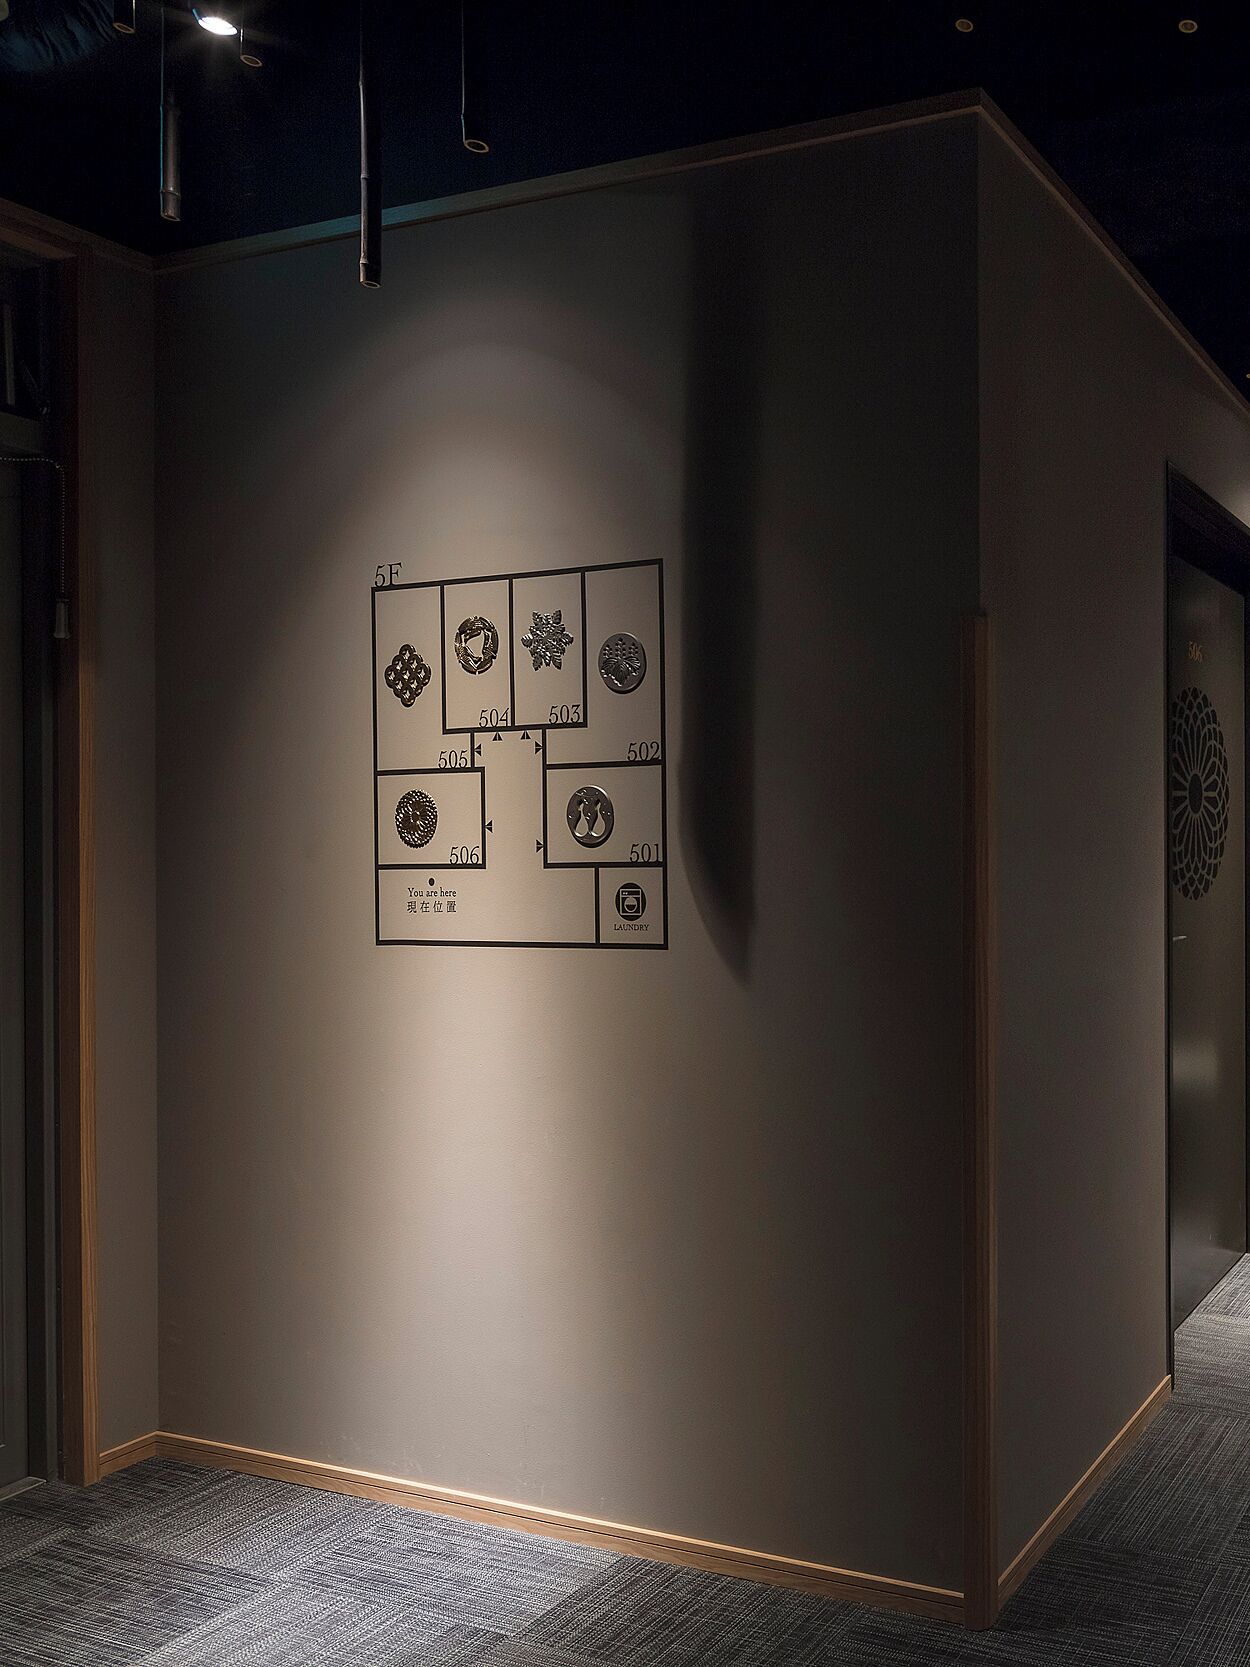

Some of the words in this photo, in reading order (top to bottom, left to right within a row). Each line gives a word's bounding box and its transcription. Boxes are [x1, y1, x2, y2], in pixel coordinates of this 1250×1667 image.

[375, 562, 402, 587] 5F
[479, 708, 509, 727] 504
[549, 704, 580, 724] 503
[438, 750, 468, 769] 505
[627, 741, 660, 761] 502
[450, 845, 480, 865] 506
[630, 843, 659, 863] 501
[407, 887, 424, 897] You
[439, 886, 457, 898] here
[406, 900, 457, 914] 現在位置
[613, 923, 650, 931] LAUNDRY
